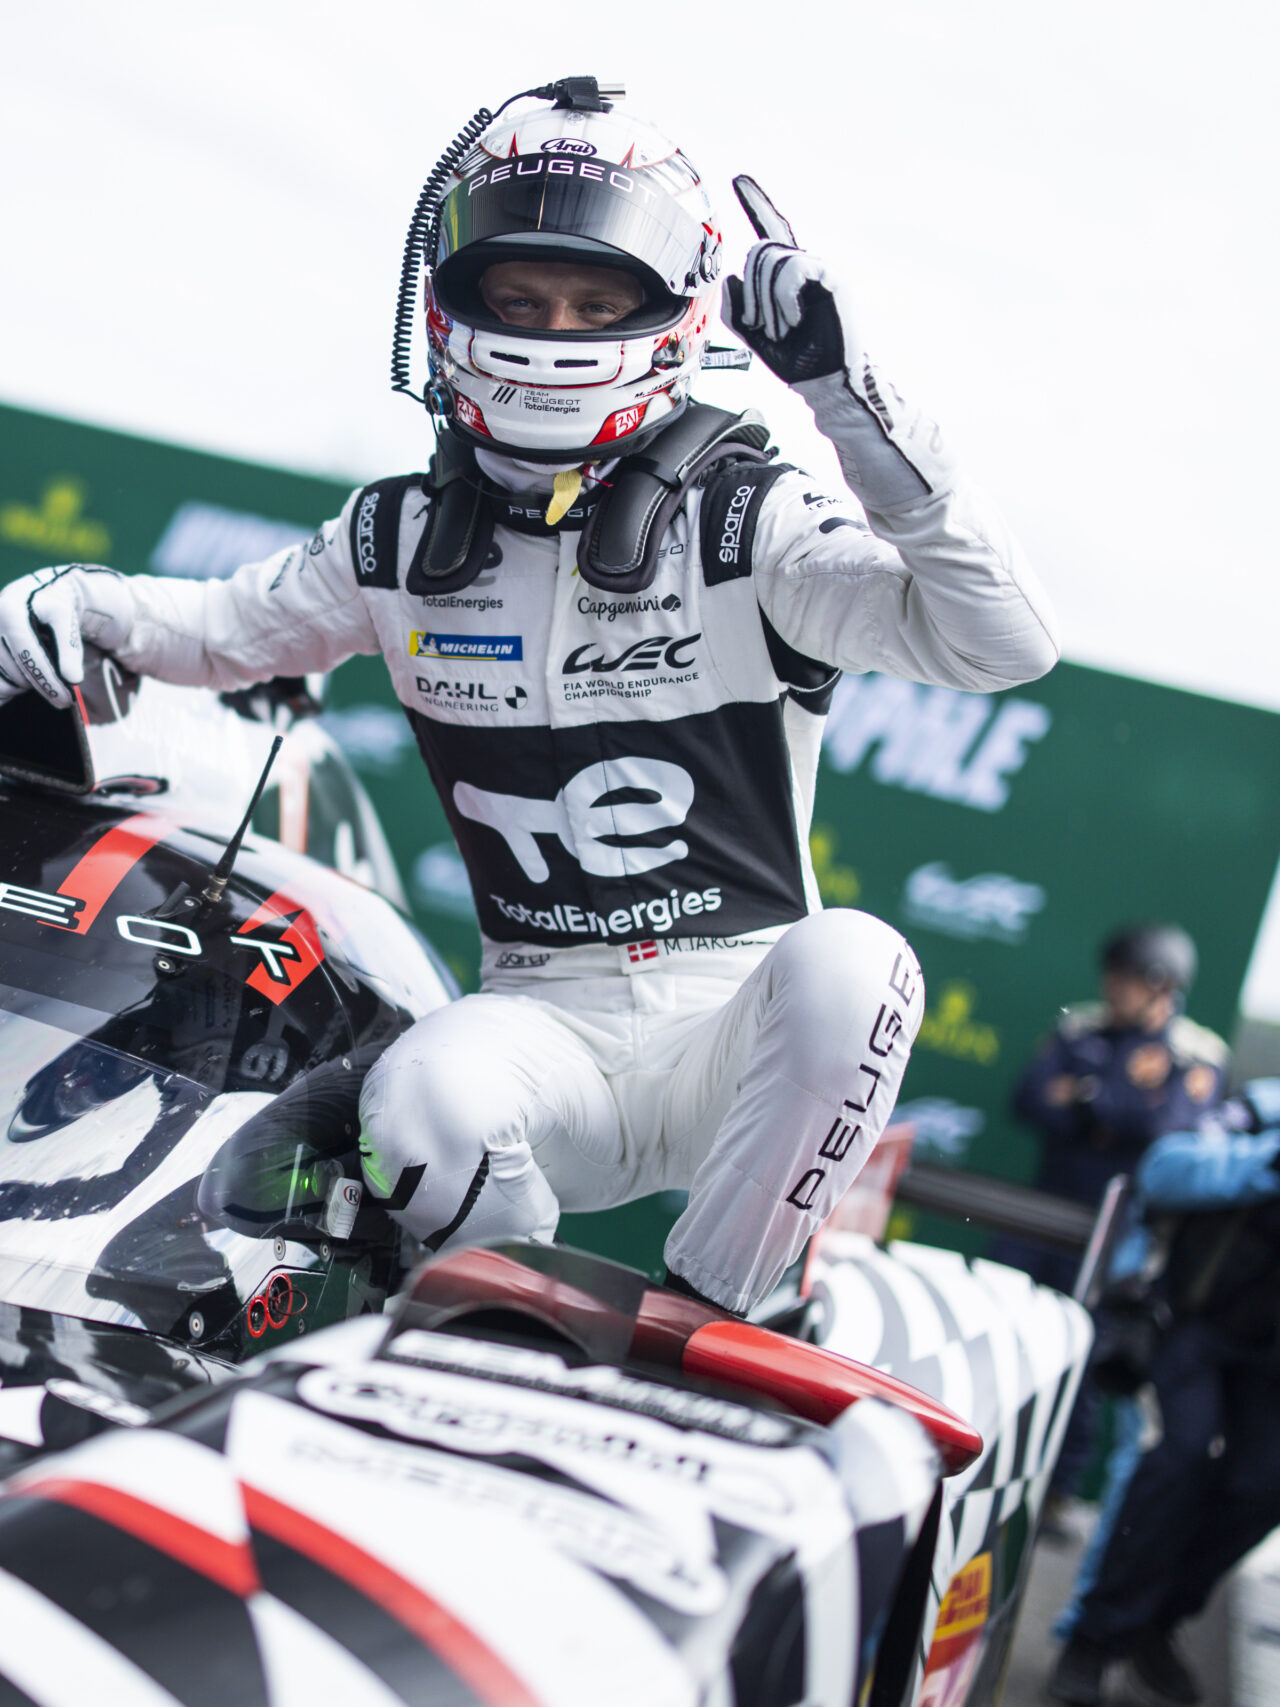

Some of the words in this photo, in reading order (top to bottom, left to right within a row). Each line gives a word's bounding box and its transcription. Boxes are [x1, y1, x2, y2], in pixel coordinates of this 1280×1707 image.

[545, 139, 590, 153] Arai
[468, 158, 657, 203] PEUGEOT
[524, 389, 549, 397] TEAM
[524, 395, 581, 406] PEUGEOT
[524, 402, 581, 414] TotalEnergies
[357, 492, 380, 573] sparco
[719, 485, 755, 564] sparco
[422, 595, 503, 611] TotalEnergies
[577, 596, 661, 622] Capgemini
[440, 643, 514, 655] MICHELIN
[562, 632, 702, 675] WEC
[21, 649, 59, 699] sparco
[563, 682, 583, 691] FIA
[586, 679, 625, 690] WORLD
[628, 672, 700, 689] ENDURANCE
[416, 676, 498, 700] DAHL
[564, 688, 652, 701] CHAMPIONSHIP
[490, 887, 723, 938] TotalEnergies
[776, 942, 923, 1211] PEUGE
